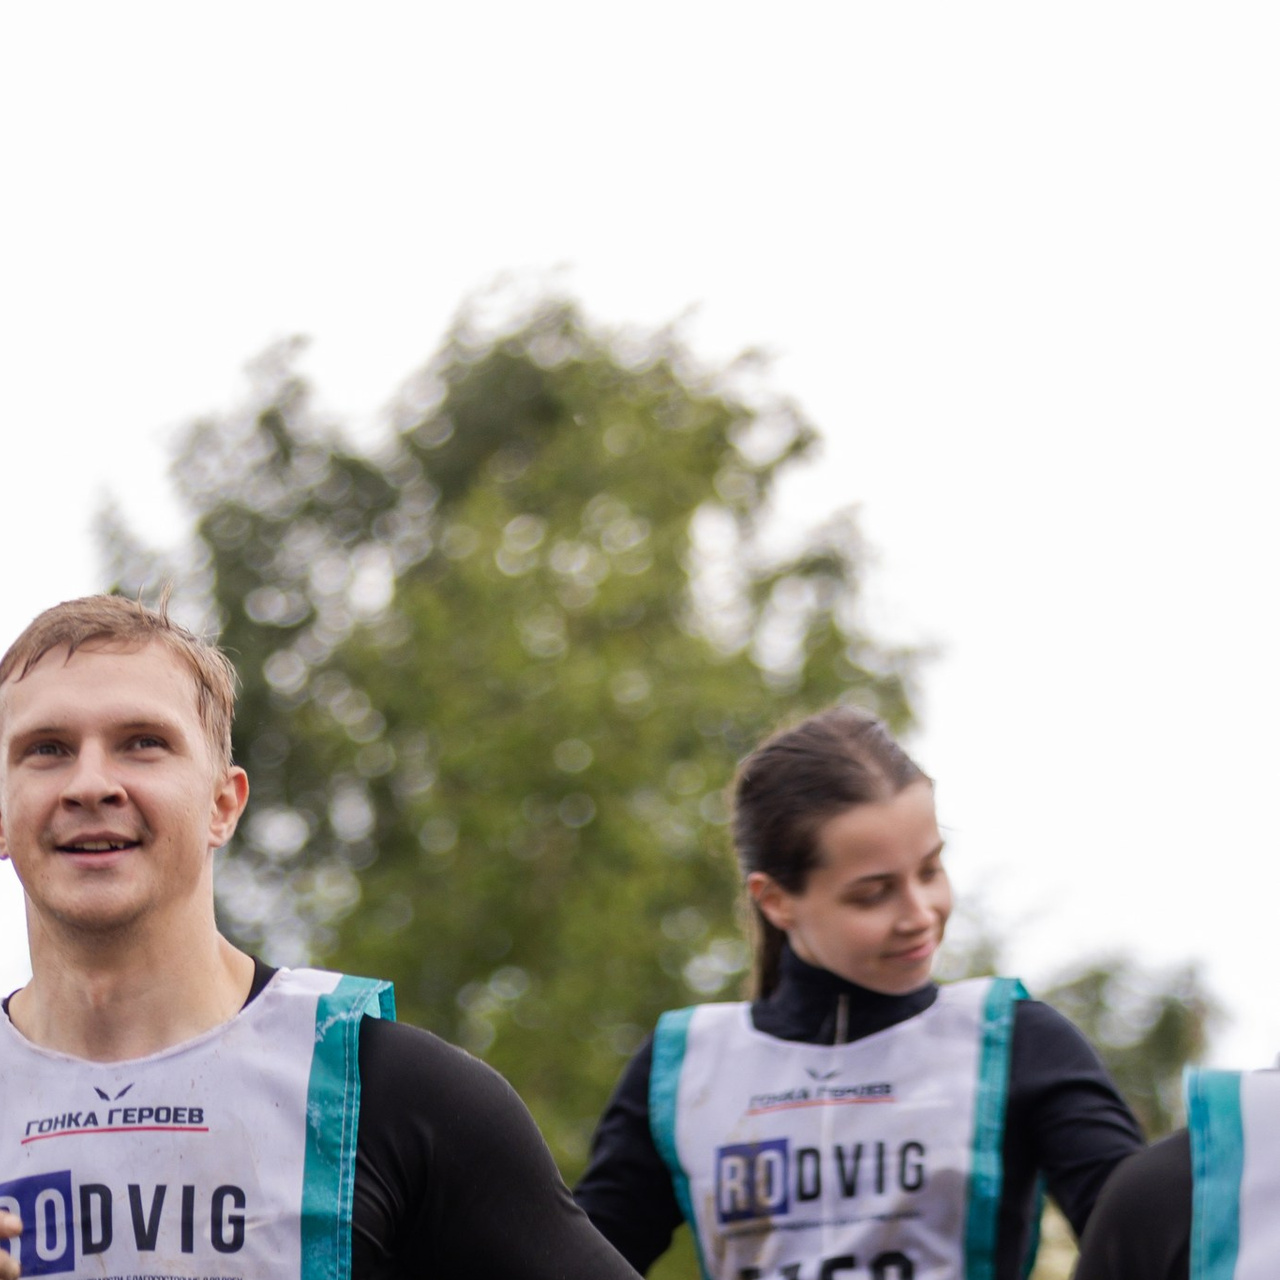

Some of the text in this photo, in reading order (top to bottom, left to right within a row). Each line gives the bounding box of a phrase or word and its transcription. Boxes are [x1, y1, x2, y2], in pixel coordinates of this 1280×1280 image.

[25, 1106, 205, 1136] ГОНКА ГЕРОЕВ
[720, 1141, 926, 1215] RODVIG
